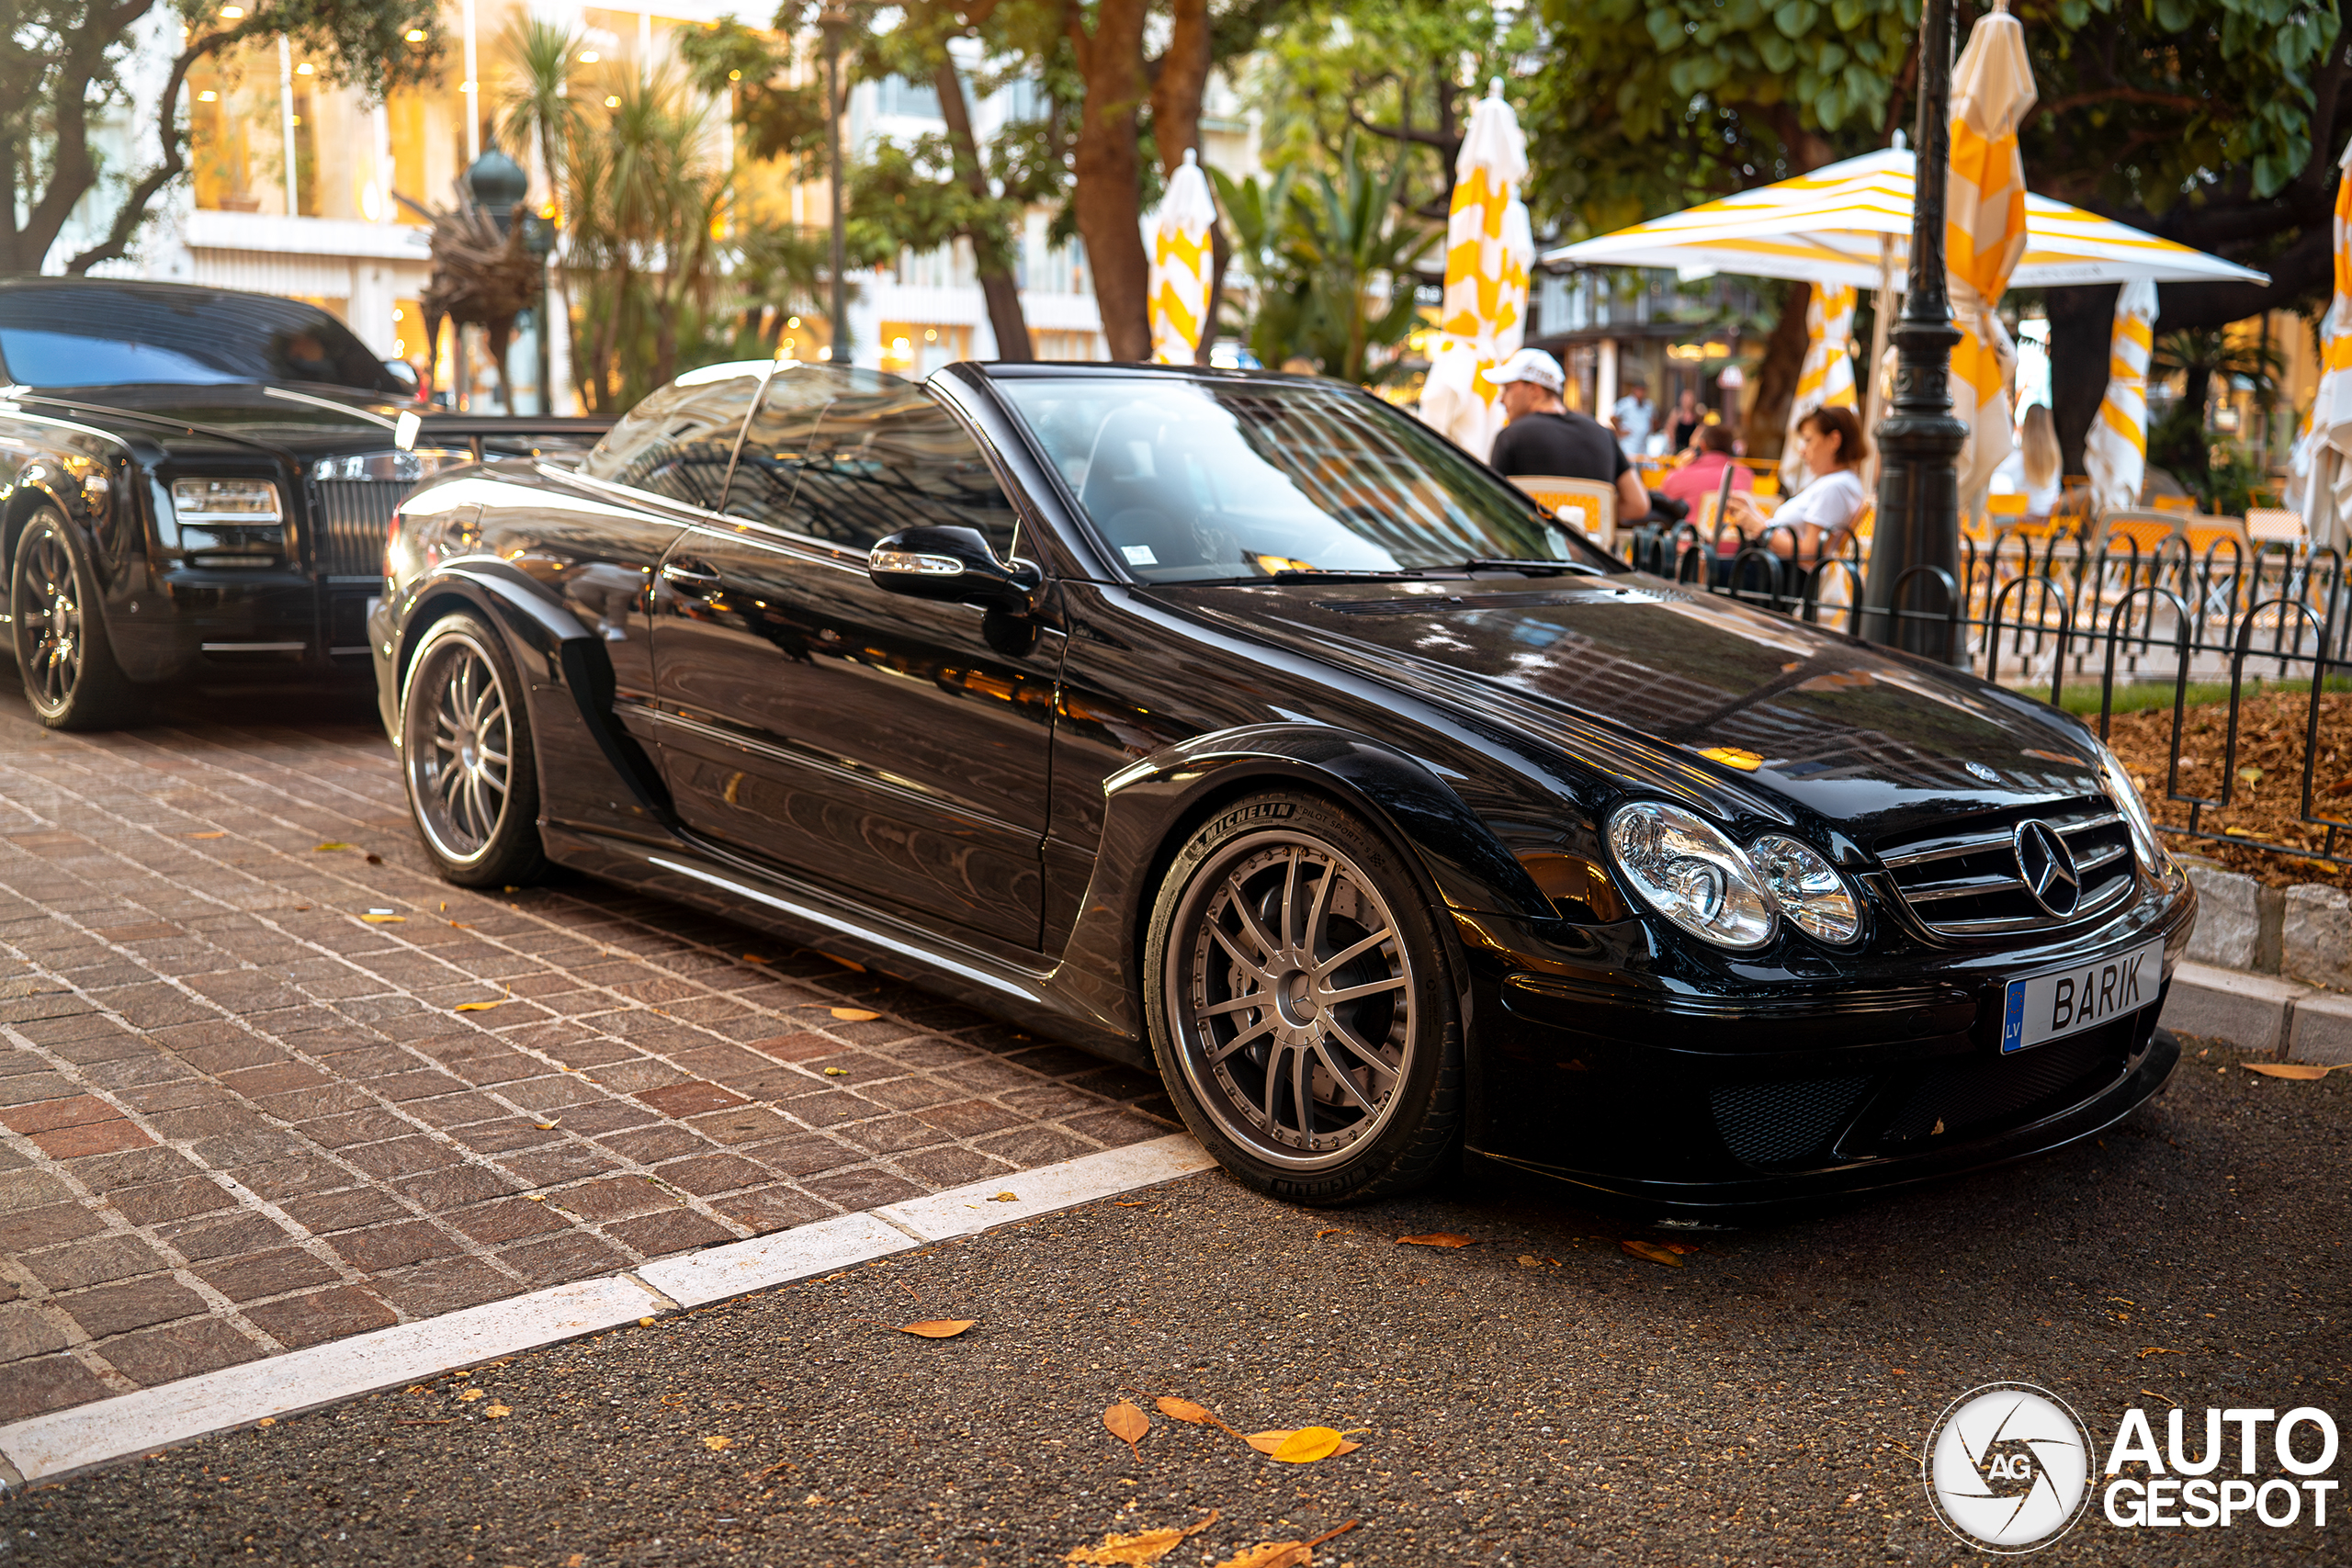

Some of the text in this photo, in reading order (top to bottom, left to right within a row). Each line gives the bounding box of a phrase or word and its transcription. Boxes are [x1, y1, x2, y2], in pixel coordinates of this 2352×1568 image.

[1204, 803, 1291, 842] MICHELIN
[1302, 807, 1329, 823] PILOT
[2052, 951, 2145, 1032] BARIK
[2006, 1021, 2020, 1039] LV
[1275, 1166, 1368, 1197] MICHELIN
